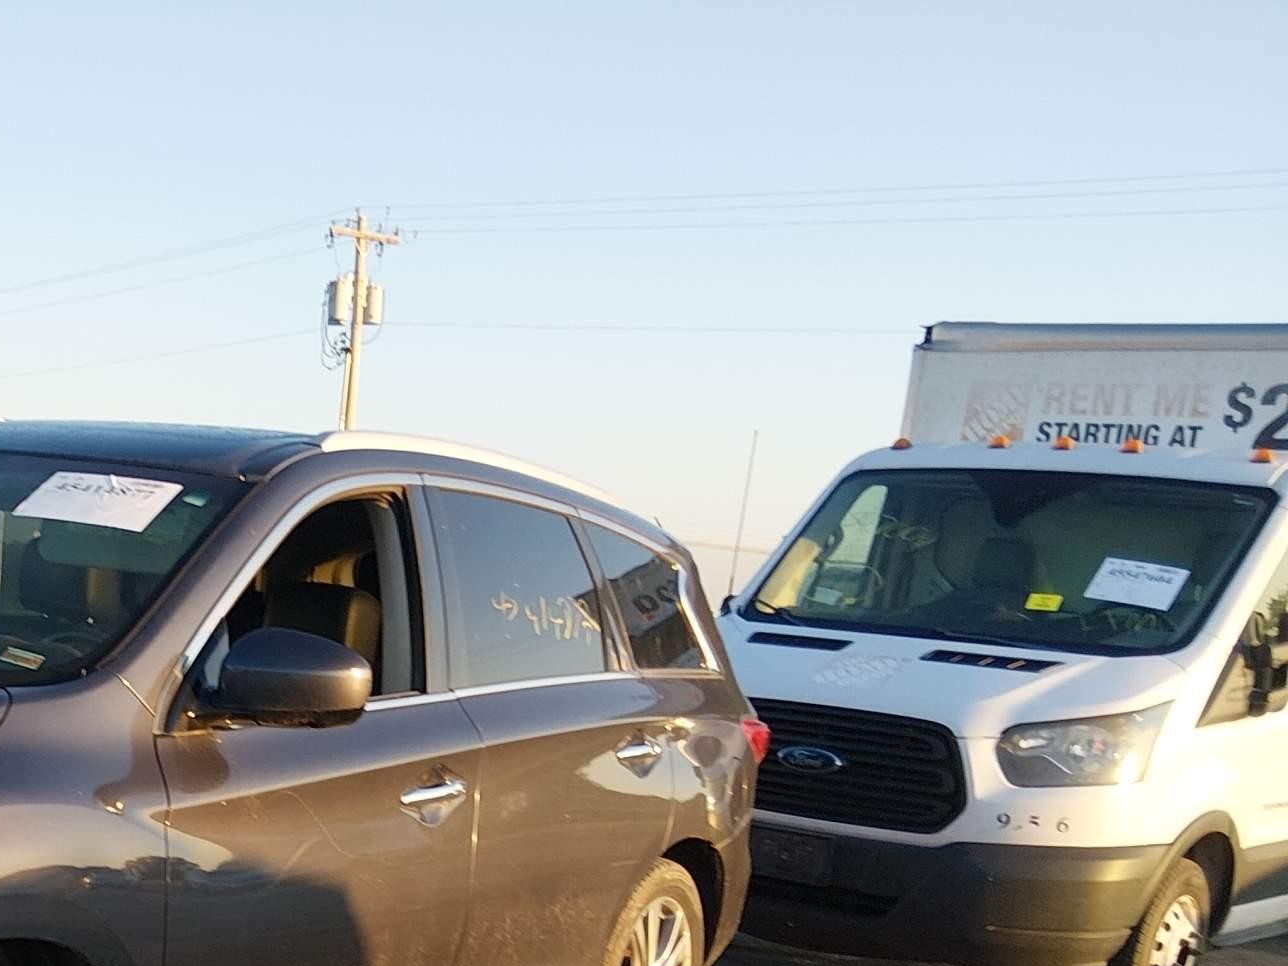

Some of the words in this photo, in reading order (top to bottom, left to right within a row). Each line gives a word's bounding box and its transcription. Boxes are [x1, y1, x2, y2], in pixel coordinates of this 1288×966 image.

[1043, 384, 1136, 417] RENT
[1153, 384, 1210, 419] ME
[1036, 421, 1161, 446] STARTING
[1169, 425, 1203, 448] AT
